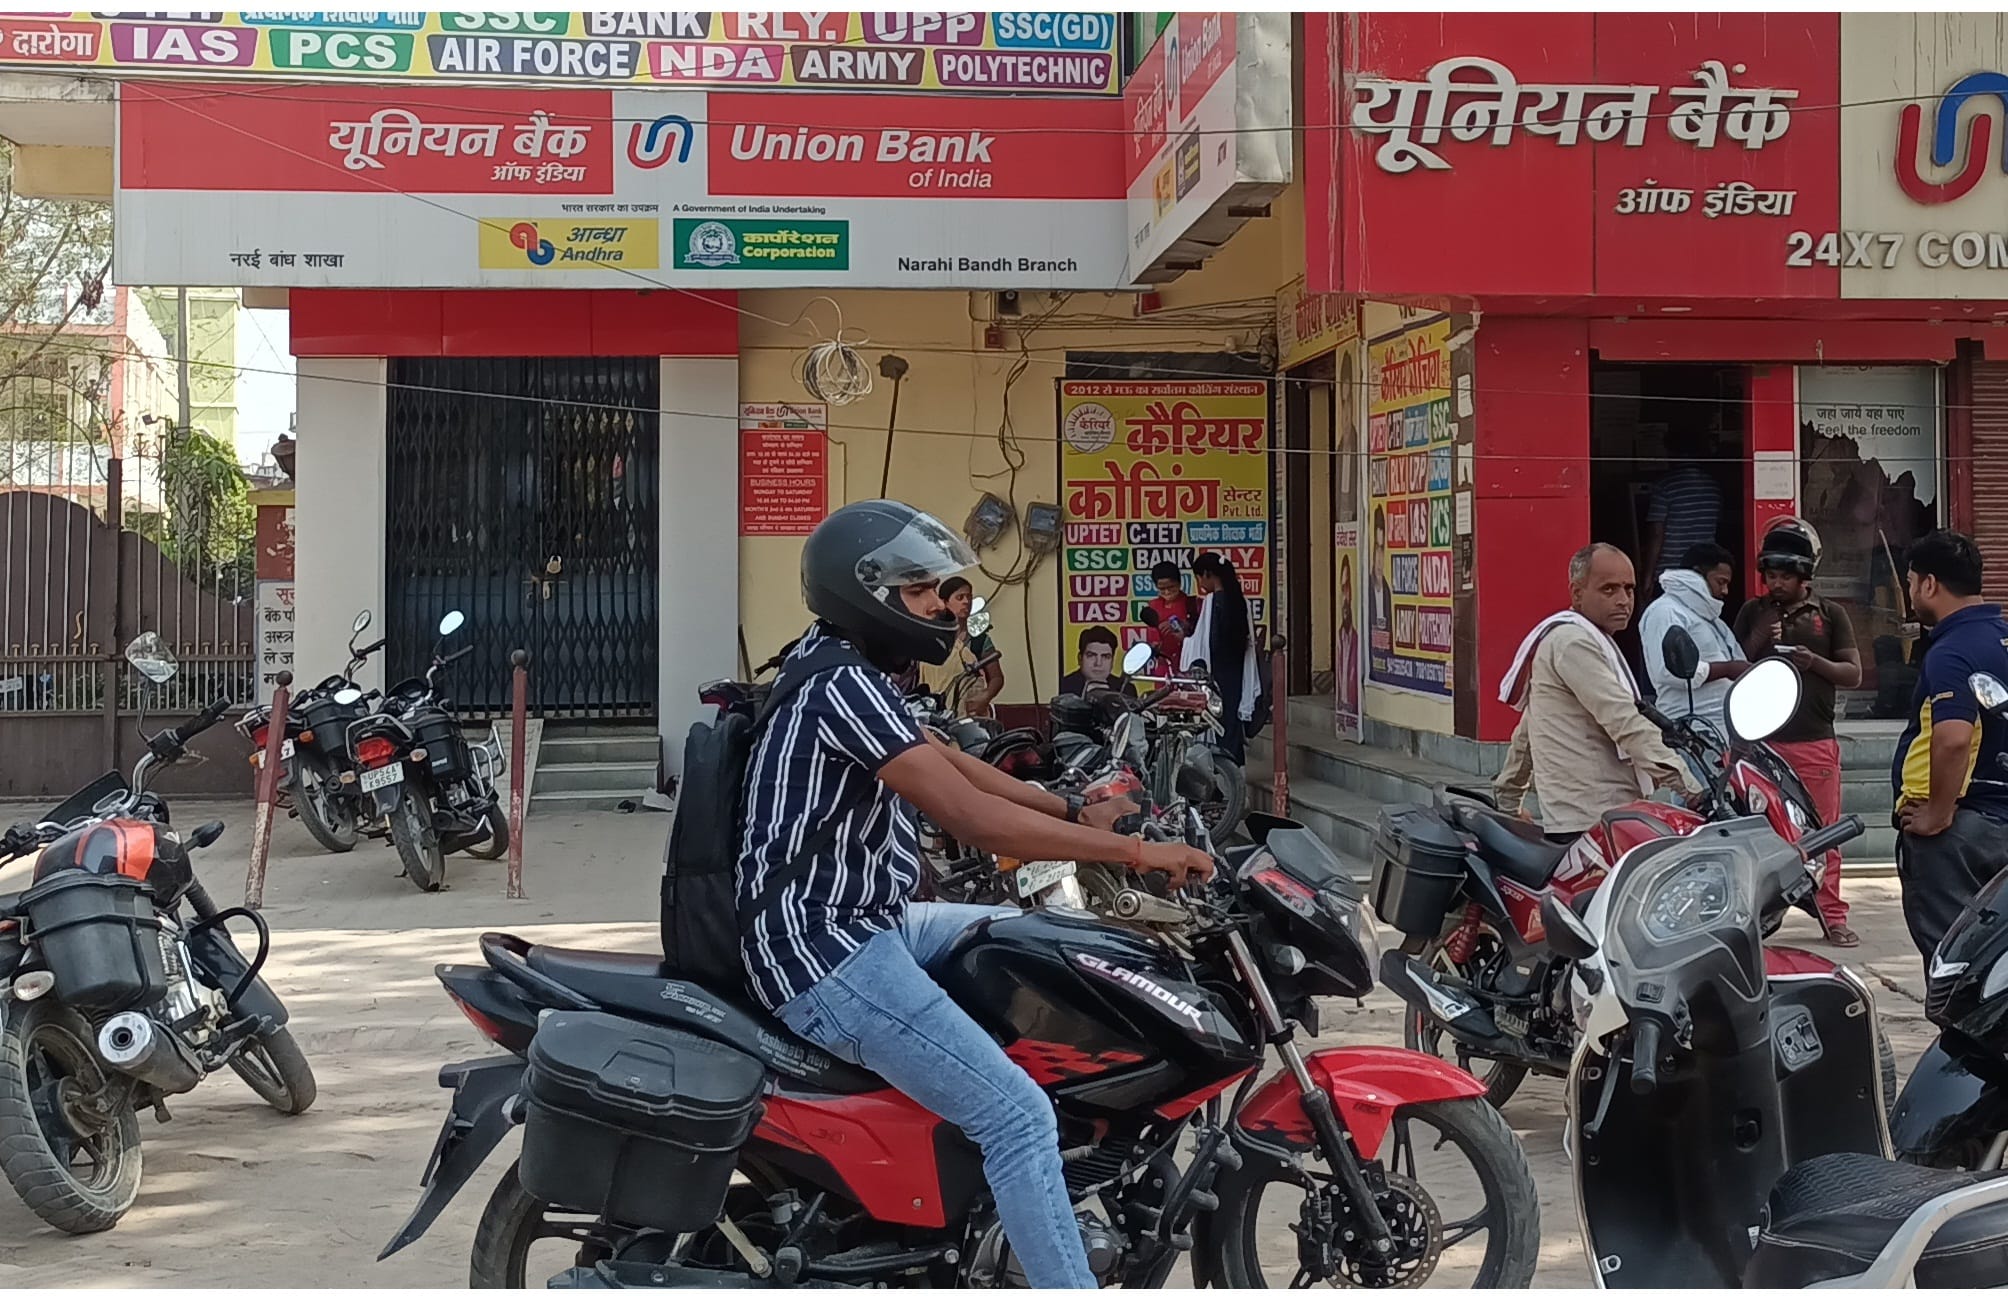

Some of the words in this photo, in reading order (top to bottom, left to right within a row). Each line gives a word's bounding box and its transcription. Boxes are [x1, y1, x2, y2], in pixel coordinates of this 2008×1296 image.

[454, 12, 557, 31] SSC
[591, 12, 703, 37] BANK
[738, 12, 837, 40] RLY.
[874, 12, 977, 43] UPP
[998, 13, 1110, 47] SSC(GD)
[12, 24, 95, 57] दारोगा
[133, 27, 240, 63] IAS
[289, 32, 397, 69] PCS
[438, 37, 501, 72] AIR
[513, 40, 631, 77] FORCE
[660, 45, 775, 80] NDA
[800, 50, 916, 81] ARMY
[942, 54, 1105, 85] POLYTECHNIC
[1352, 56, 1659, 172] यूनियन
[1668, 60, 1798, 150] बैंक
[328, 108, 504, 170] यूनियन
[513, 109, 592, 158] बैंक
[730, 125, 865, 163] Union
[876, 129, 996, 165] Bank
[491, 162, 532, 182] ऑफ
[535, 164, 588, 184] इंडिया
[908, 168, 933, 190] of
[937, 168, 993, 190] India
[562, 203, 584, 213] भारत
[586, 203, 615, 213] सरकार
[617, 203, 630, 213] का
[631, 203, 660, 214] उपक्रम
[673, 205, 681, 213] A
[682, 204, 736, 213] Government
[738, 205, 747, 213] of
[749, 205, 771, 213] India
[772, 205, 827, 215] Undertaking
[1615, 178, 1695, 216] ऑफ
[1703, 182, 1797, 218] इंडिया
[566, 226, 628, 244] आन्ध्रा
[1786, 230, 1905, 269] 24X7
[230, 249, 261, 269] नरई
[304, 252, 345, 269] शाखा
[560, 247, 624, 262] Andhra
[743, 246, 836, 261] Corporation
[898, 256, 954, 273] Narahi
[958, 257, 1012, 273] Bandh
[1018, 257, 1078, 273] Branch
[1071, 384, 1100, 395] 2012
[1125, 401, 1265, 455] कैरियर
[1432, 400, 1450, 440] SSC
[1818, 423, 1845, 436] Feel
[1848, 423, 1867, 436] the
[1870, 423, 1921, 437] freedom
[1067, 461, 1221, 520] कोचिंग
[1223, 486, 1263, 502] सेन्टर
[1222, 505, 1243, 518] Pvt.
[1246, 505, 1264, 518] Ltd.
[1409, 503, 1428, 544] IAS
[1432, 499, 1450, 545] PCS
[1067, 524, 1121, 544] UPTET
[1129, 524, 1182, 544] C-TET
[1074, 549, 1123, 569] SSC
[1075, 575, 1125, 597] UPP
[1422, 555, 1451, 594] NDA
[1076, 603, 1121, 622] IAS
[1075, 952, 1207, 1034] GLAMOUR
